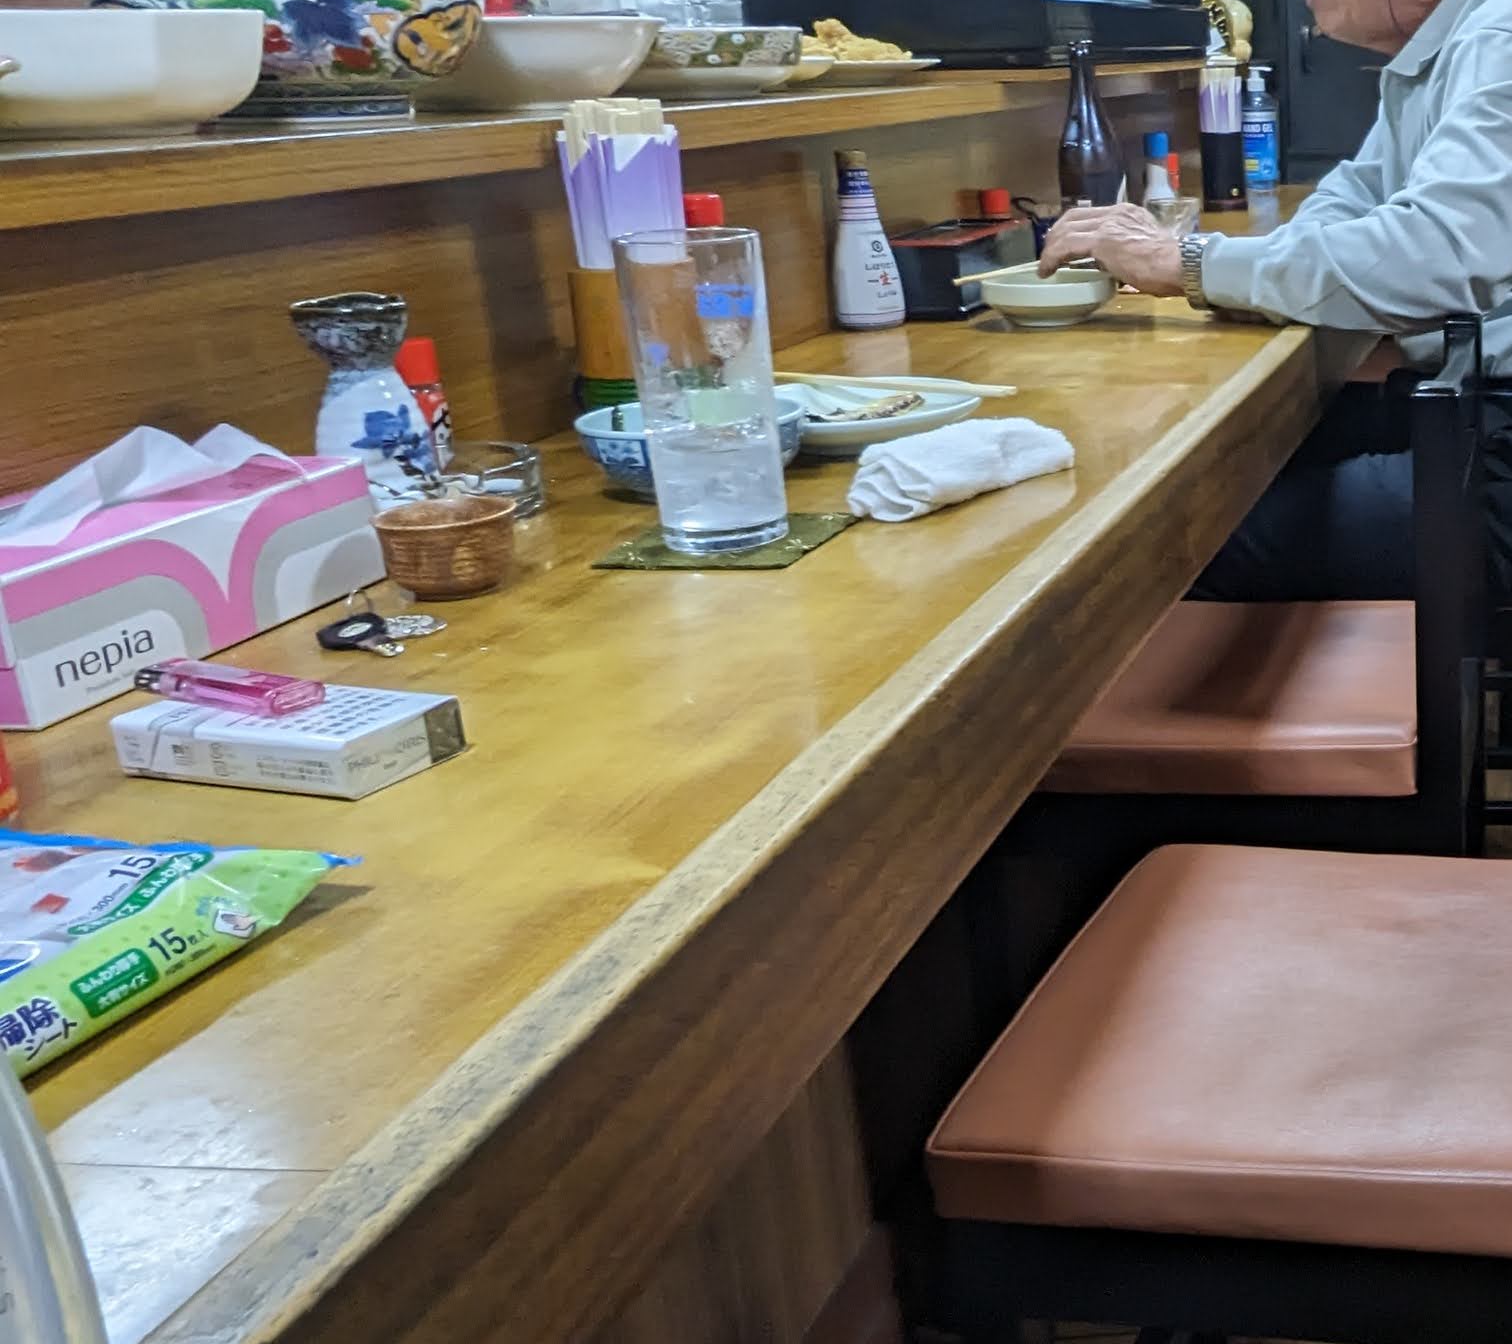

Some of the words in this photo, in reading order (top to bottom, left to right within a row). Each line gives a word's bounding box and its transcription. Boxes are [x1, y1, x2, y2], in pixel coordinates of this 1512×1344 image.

[54, 629, 155, 688] nepia
[24, 1017, 78, 1062] シート
